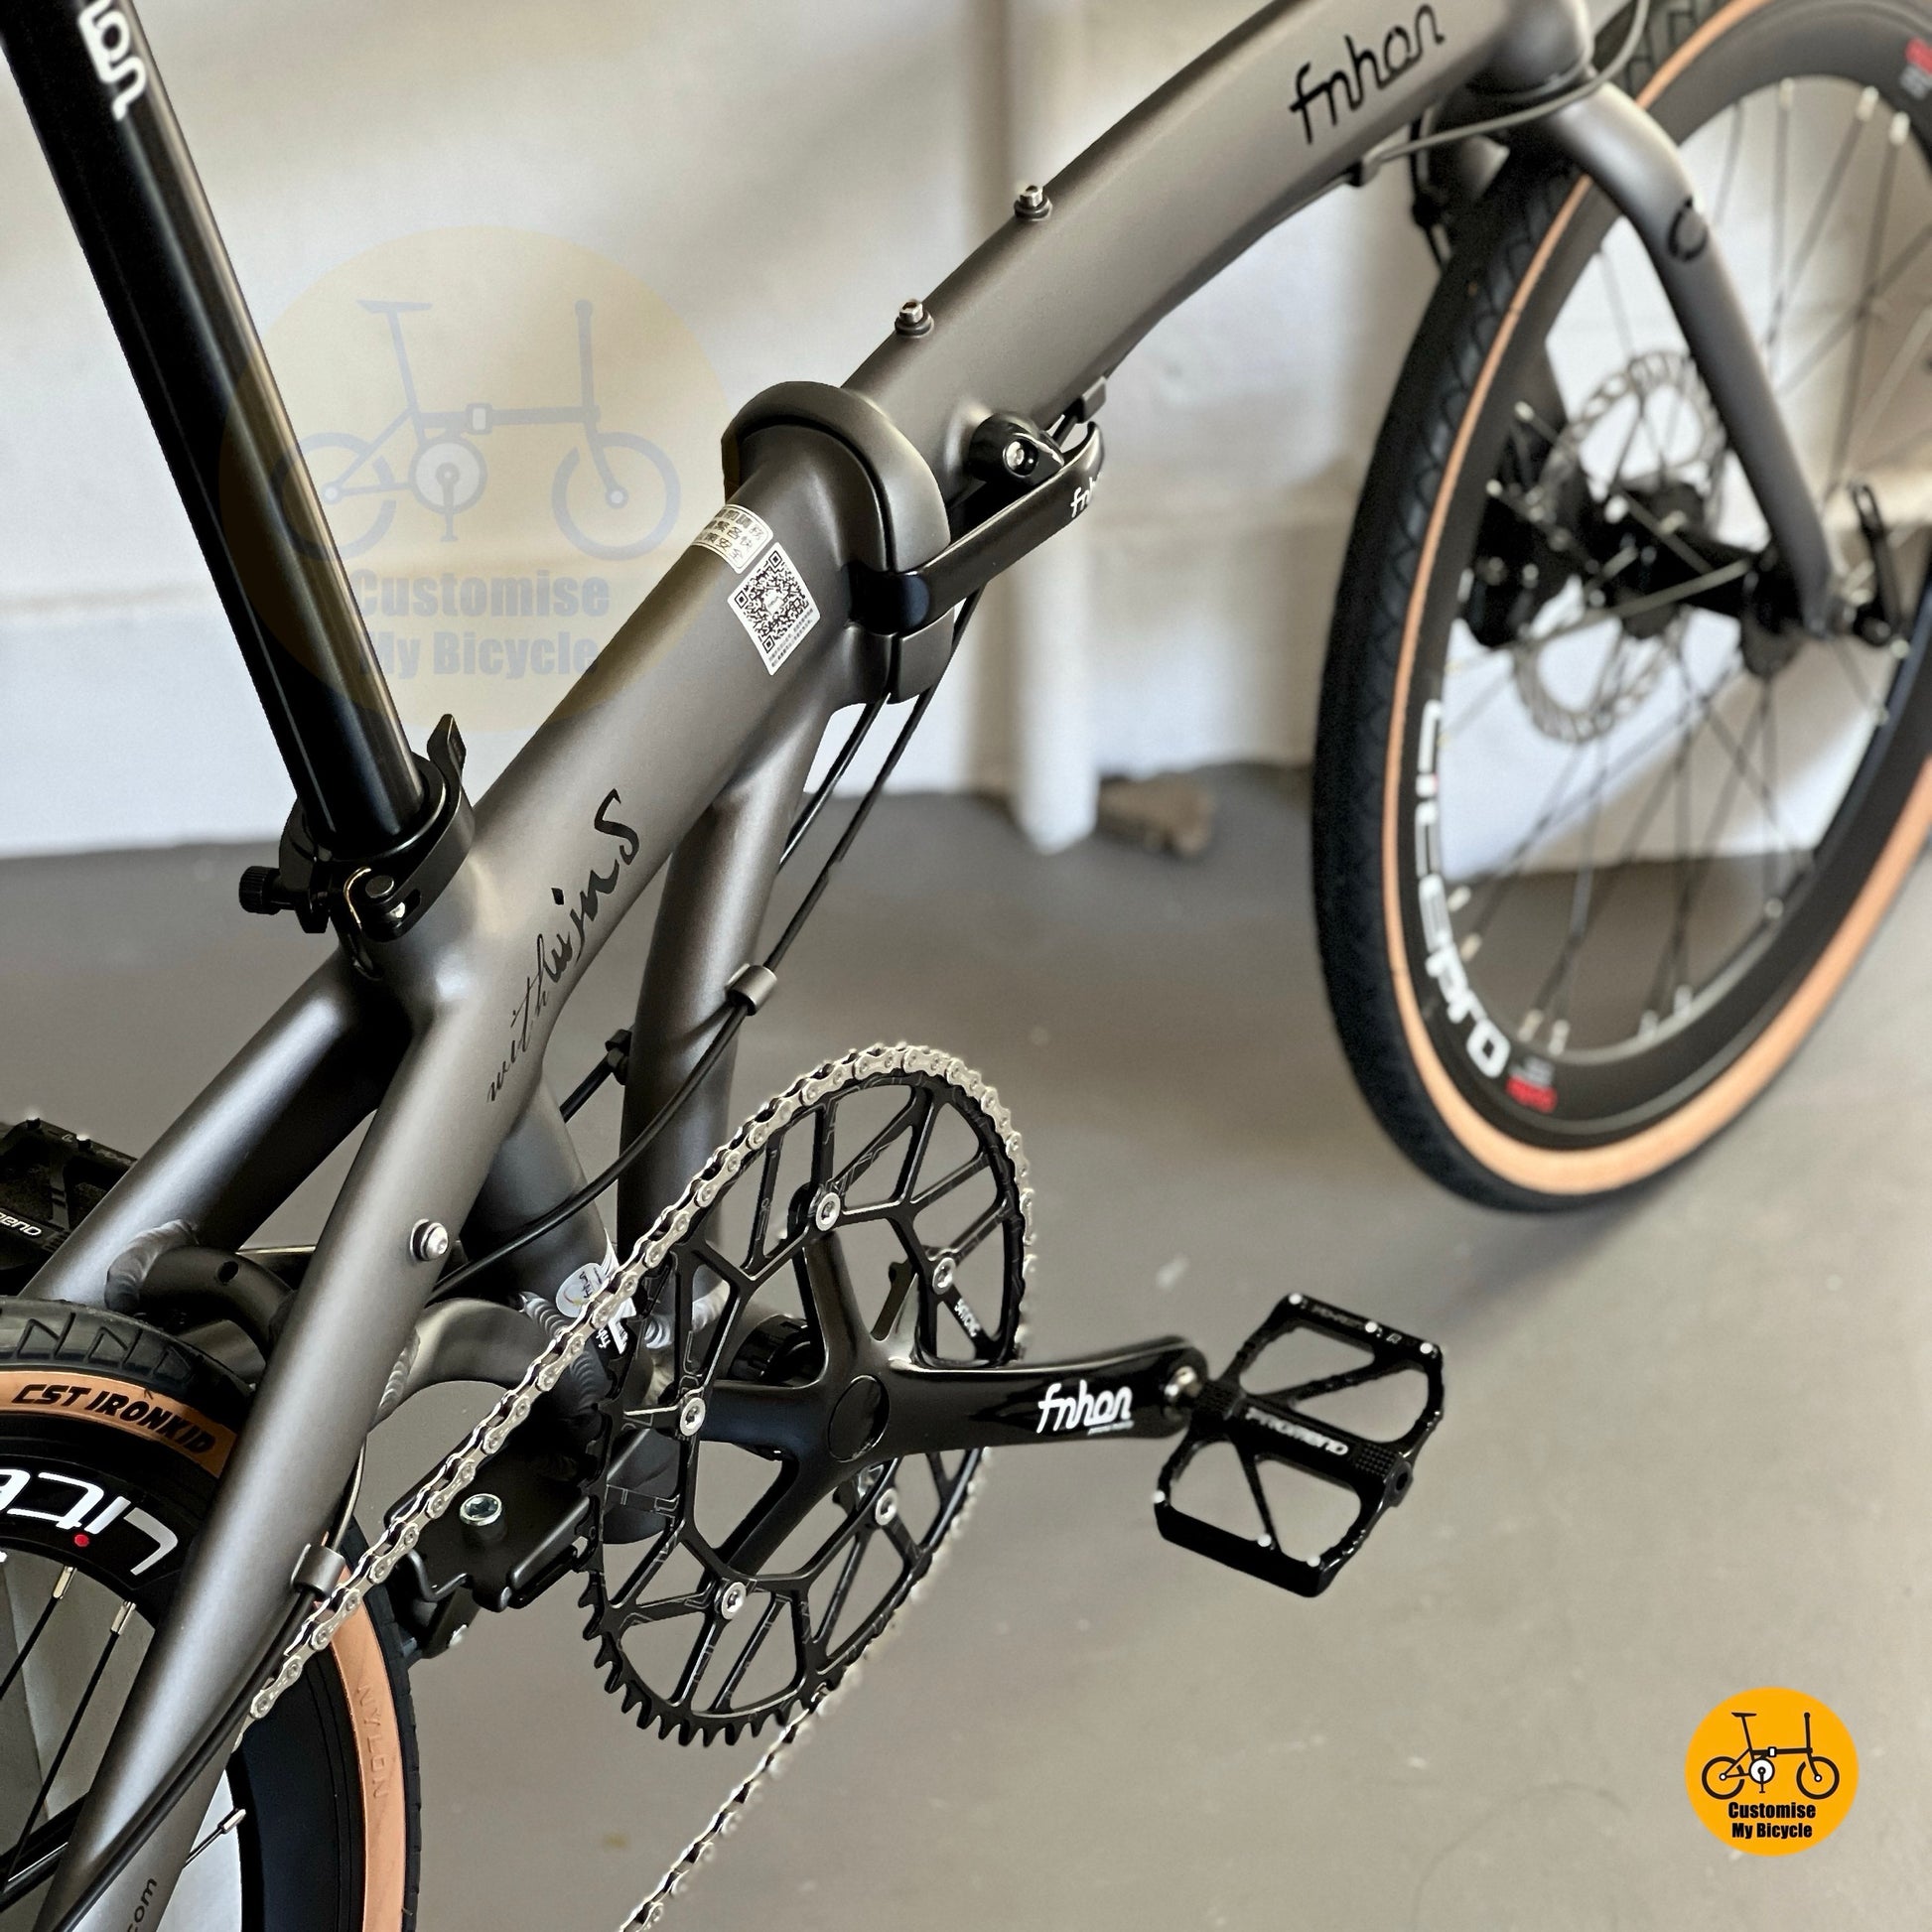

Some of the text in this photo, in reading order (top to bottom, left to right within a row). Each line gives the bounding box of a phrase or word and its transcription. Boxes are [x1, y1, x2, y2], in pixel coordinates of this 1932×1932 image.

[1290, 4, 1445, 145] fnhon
[11, 1384, 215, 1454] CST IRONKID
[1035, 1378, 1133, 1434] fnhon
[356, 1683, 389, 1800] NYLON
